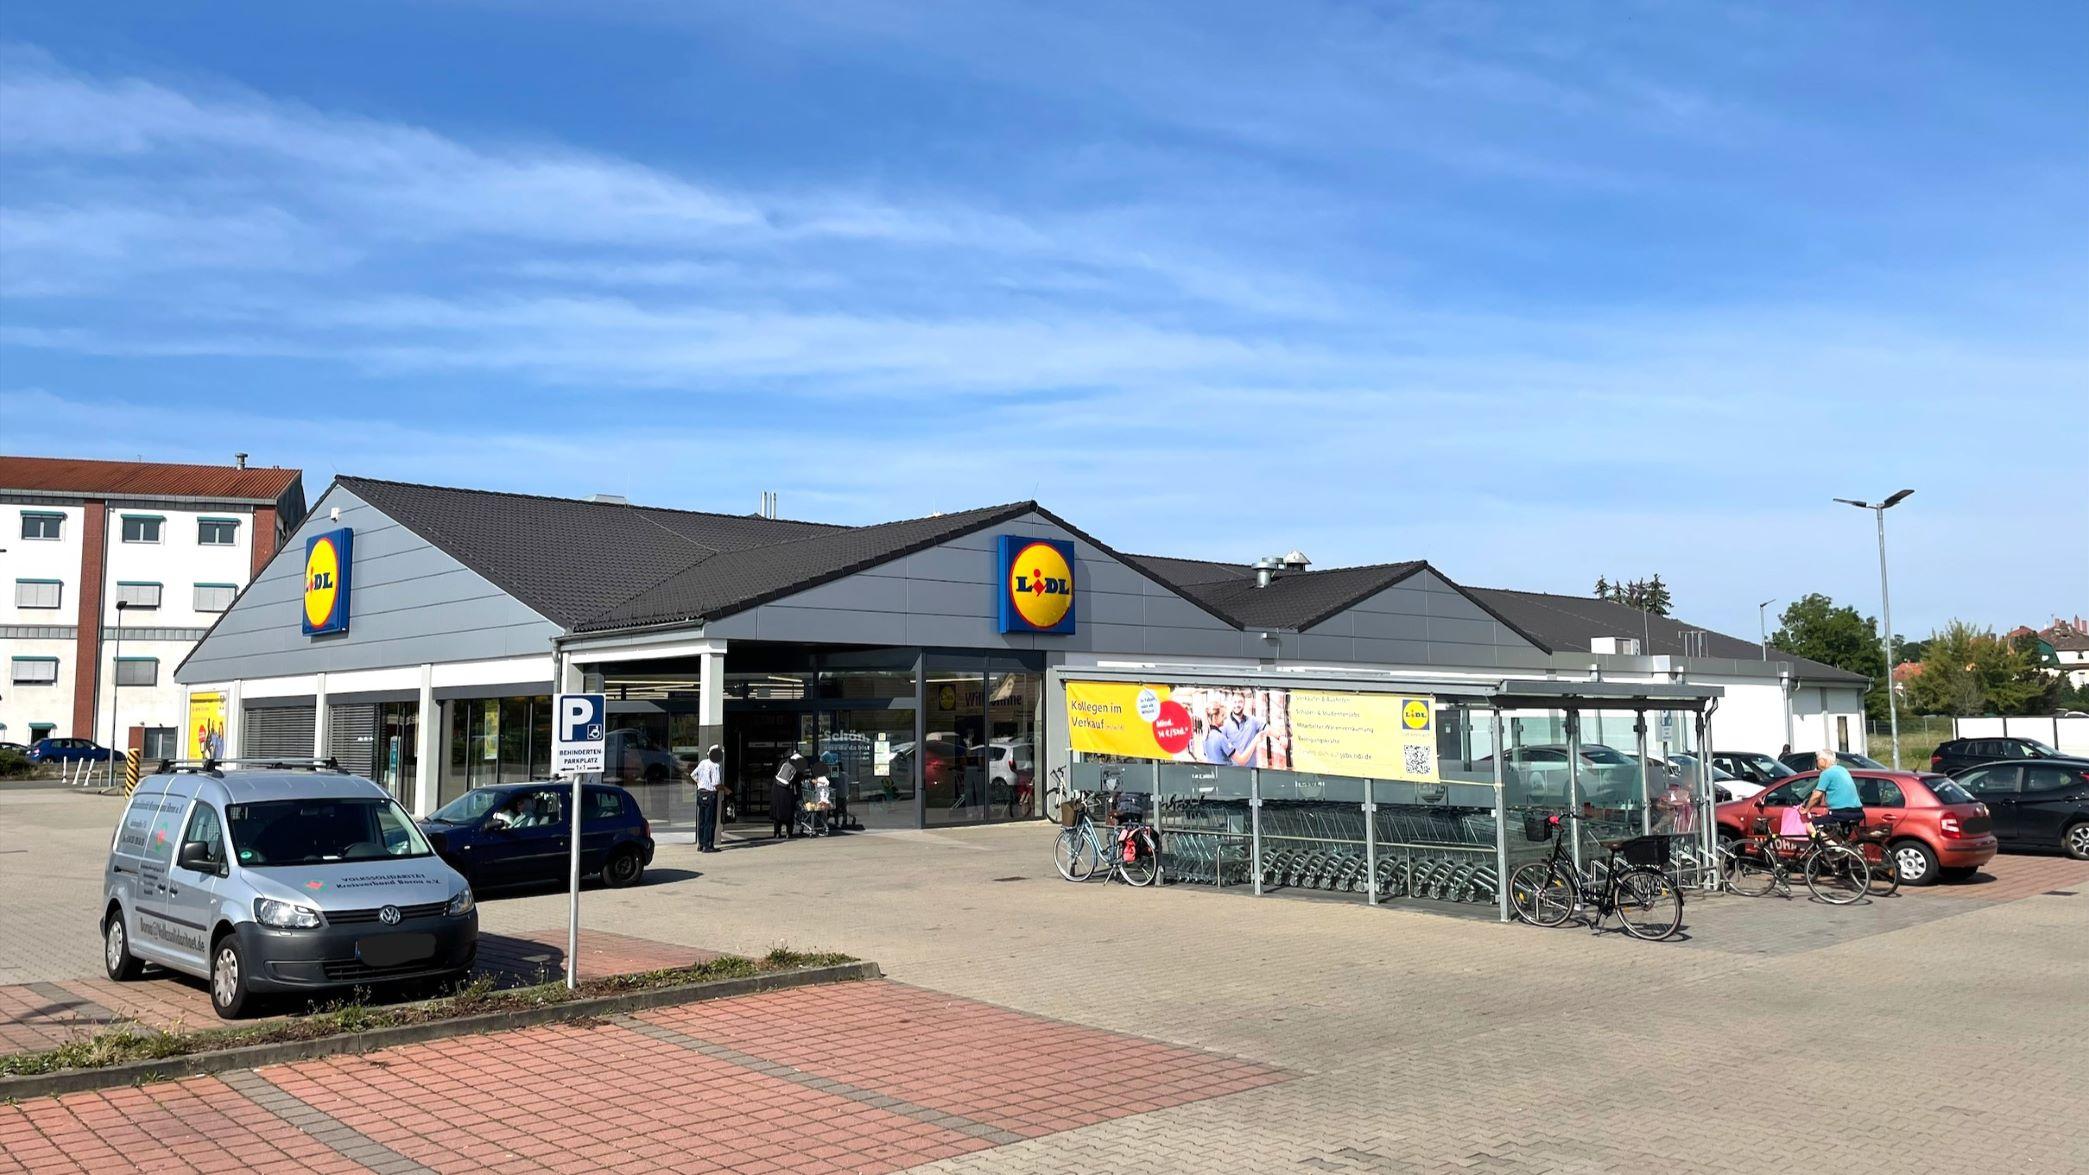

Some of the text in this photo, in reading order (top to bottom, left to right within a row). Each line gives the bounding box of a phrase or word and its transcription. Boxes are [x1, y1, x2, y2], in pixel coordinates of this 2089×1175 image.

[1071, 700, 1122, 715] Kollegen im
[562, 698, 594, 740] P
[1071, 716, 1105, 730] Verkauf
[1156, 718, 1174, 728] Mind.
